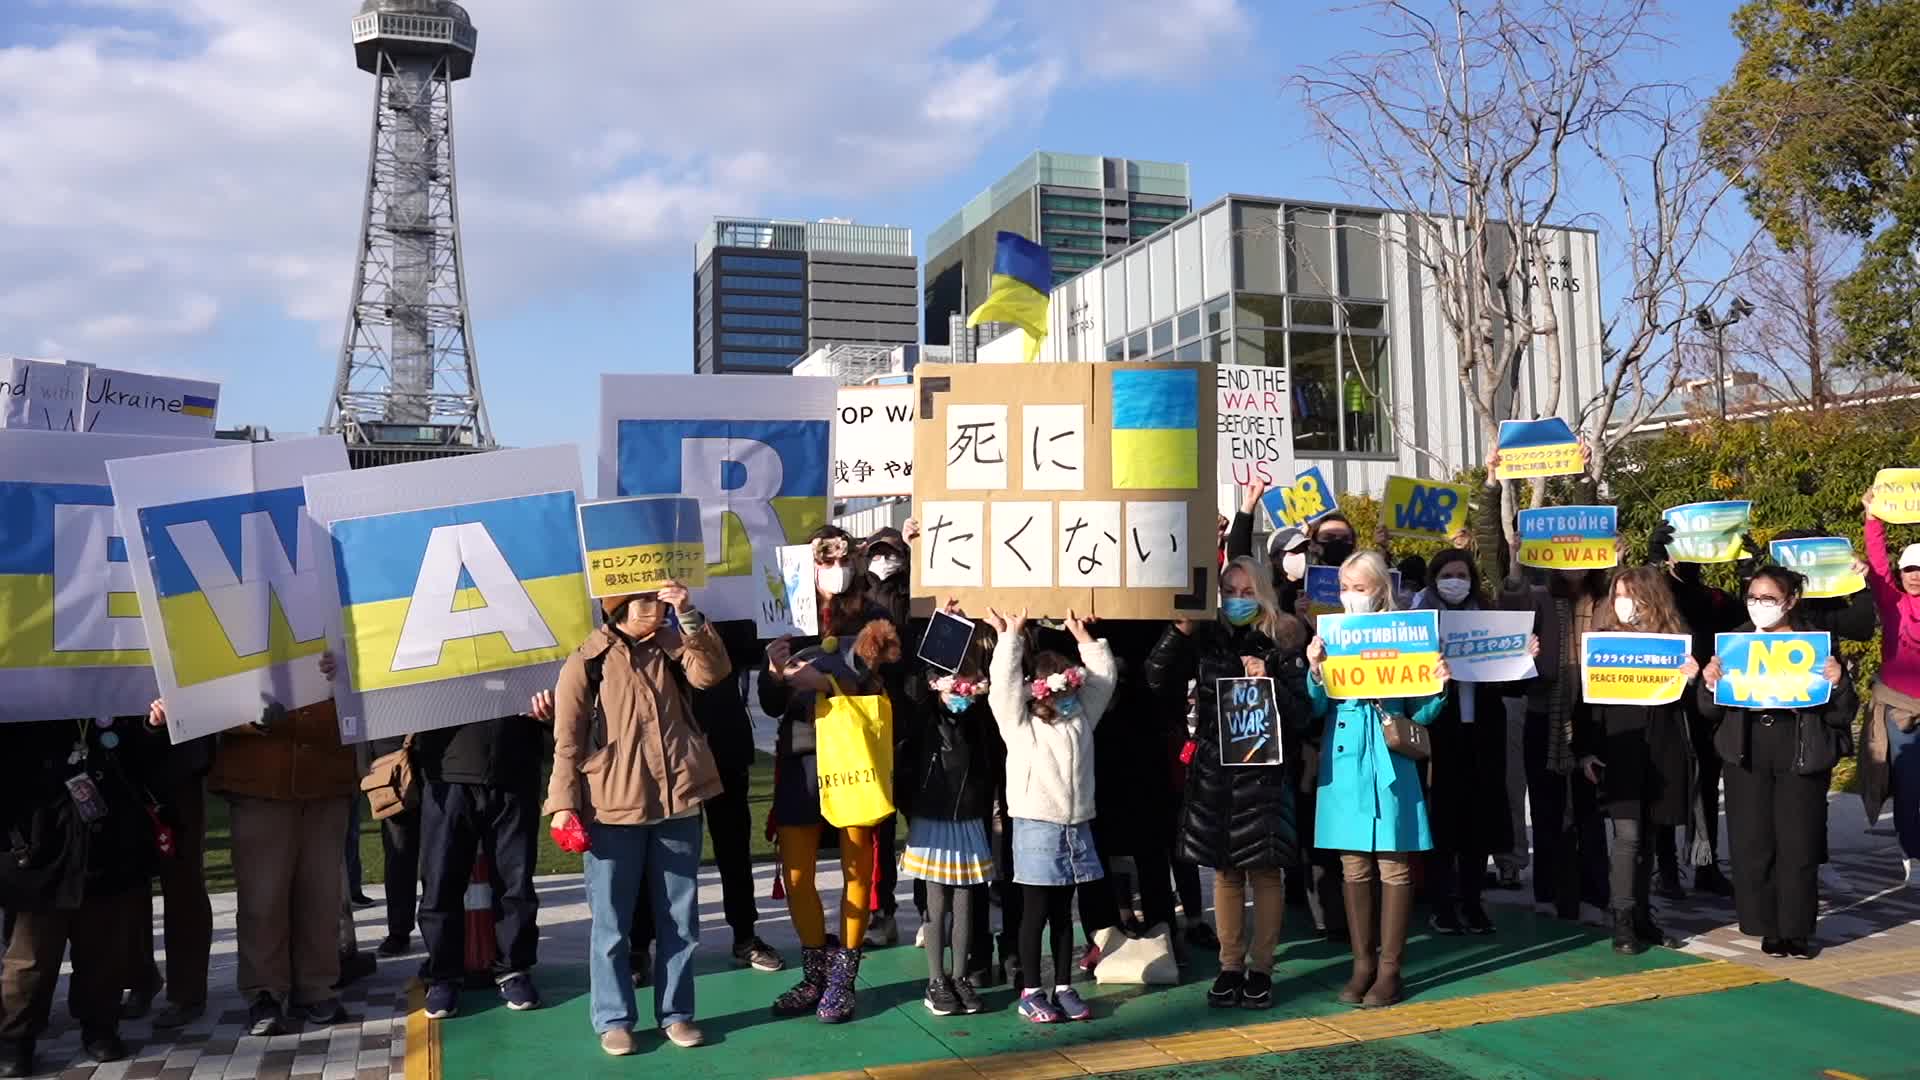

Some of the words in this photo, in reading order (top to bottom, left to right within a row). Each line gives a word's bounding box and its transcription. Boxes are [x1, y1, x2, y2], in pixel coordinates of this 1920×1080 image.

[1252, 369, 1286, 392] THE
[86, 377, 183, 413] Ukraine
[1223, 392, 1278, 414] WAR
[836, 406, 873, 425] OP
[1268, 417, 1285, 436] IT
[947, 421, 1078, 472] 死に
[1232, 437, 1279, 462] ENDS
[1232, 460, 1272, 486] US
[681, 437, 790, 564] R
[927, 514, 1178, 575] たくない
[1527, 548, 1553, 561] NO
[1563, 547, 1608, 561] WAR
[1778, 544, 1817, 567] No
[165, 510, 325, 657] W
[390, 521, 559, 672] A
[1746, 639, 1816, 677] NO
[1332, 666, 1365, 687] NO
[1376, 664, 1431, 685] WAR
[1590, 673, 1616, 683] PEACE
[1619, 674, 1634, 683] FOR
[1728, 668, 1812, 702] WAR
[1231, 686, 1260, 706] NO
